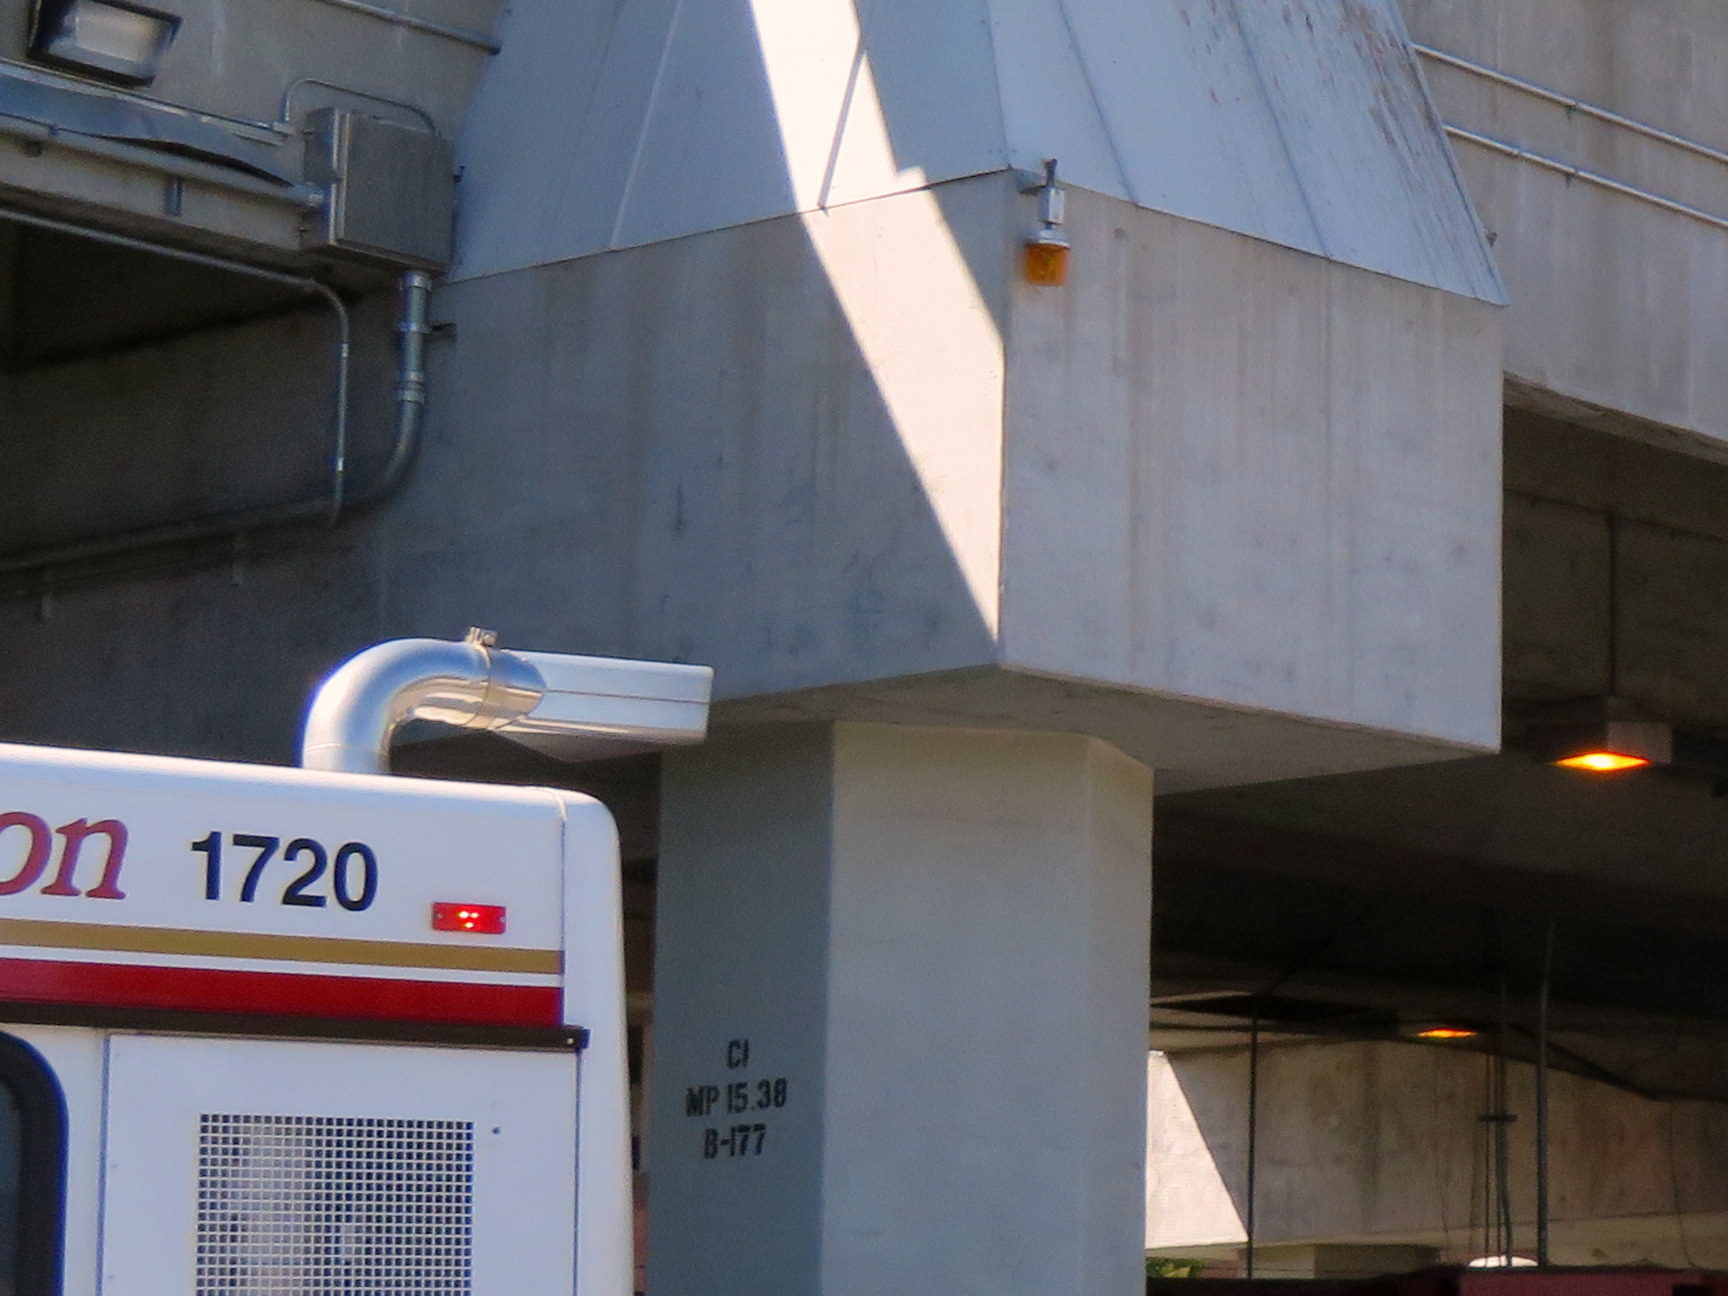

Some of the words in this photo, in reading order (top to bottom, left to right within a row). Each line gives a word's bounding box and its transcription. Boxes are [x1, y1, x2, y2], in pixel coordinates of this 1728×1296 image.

[191, 830, 378, 912] 1720
[684, 1084, 720, 1117] MP
[726, 1077, 788, 1115] 15.38
